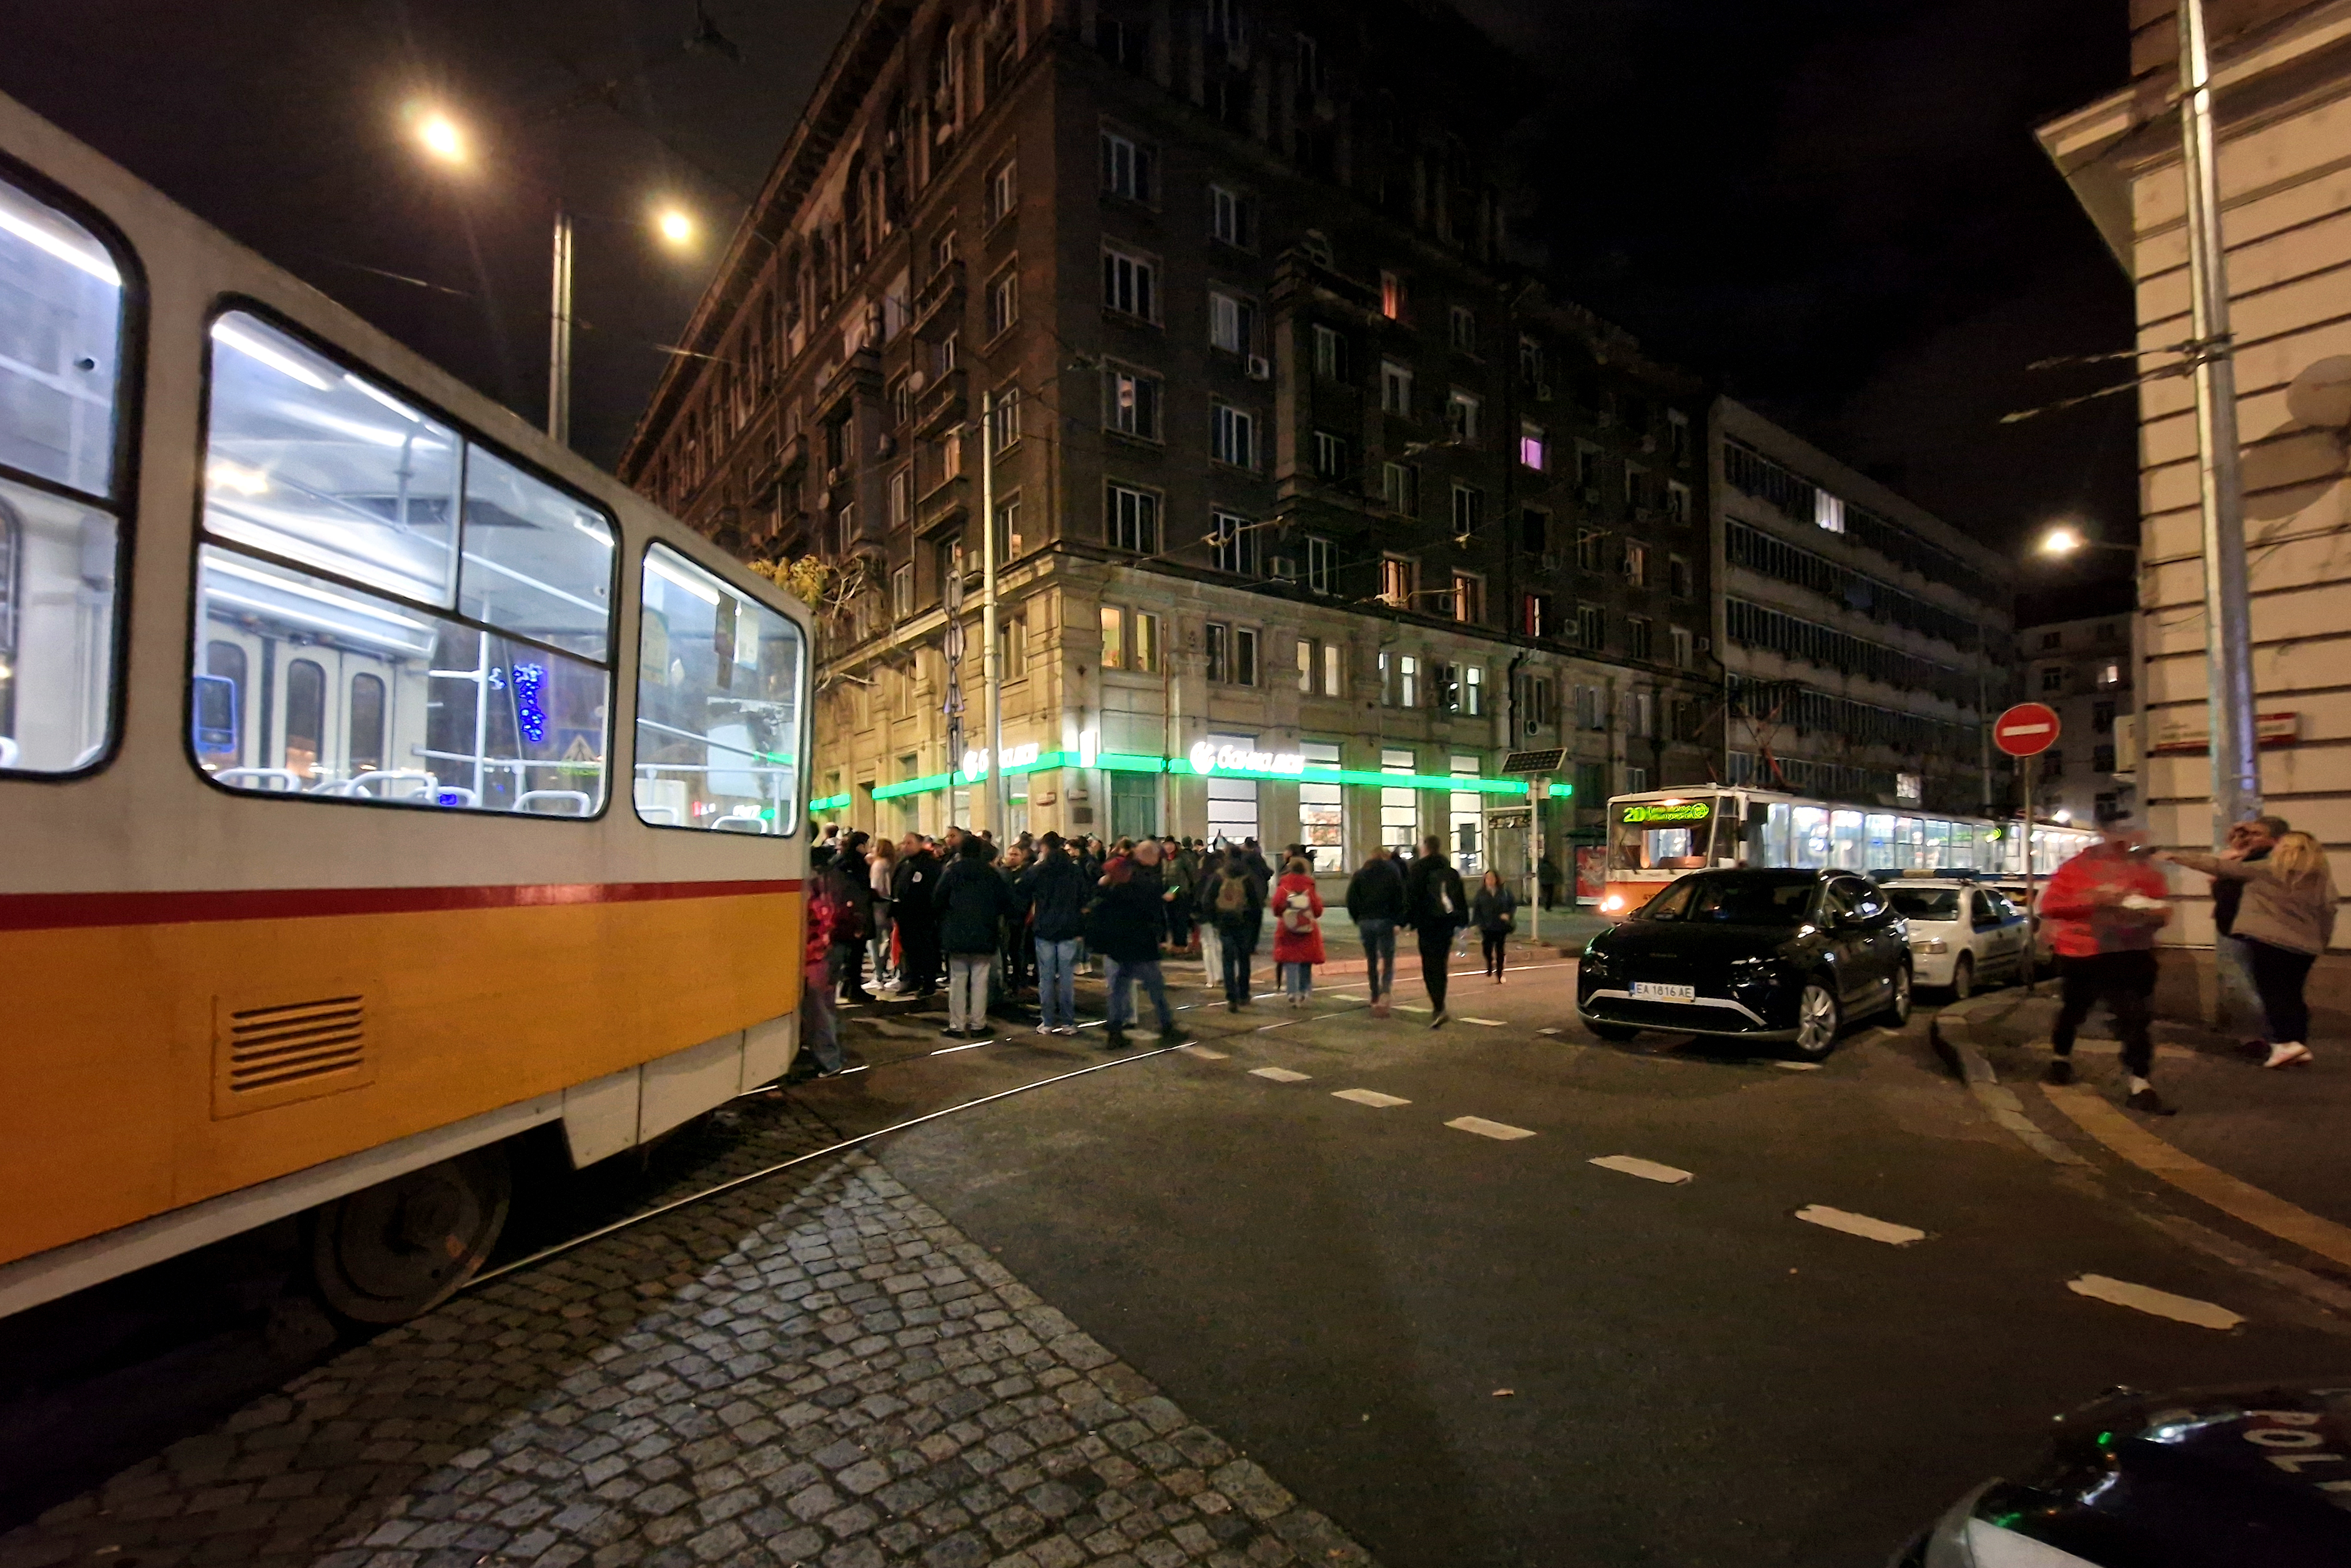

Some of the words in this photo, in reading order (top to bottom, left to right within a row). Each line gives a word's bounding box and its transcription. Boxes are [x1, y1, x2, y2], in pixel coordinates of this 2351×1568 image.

[1623, 806, 1647, 822] 20
[1636, 984, 1650, 995] EA
[1653, 985, 1676, 997] 1816
[1678, 987, 1692, 998] AE
